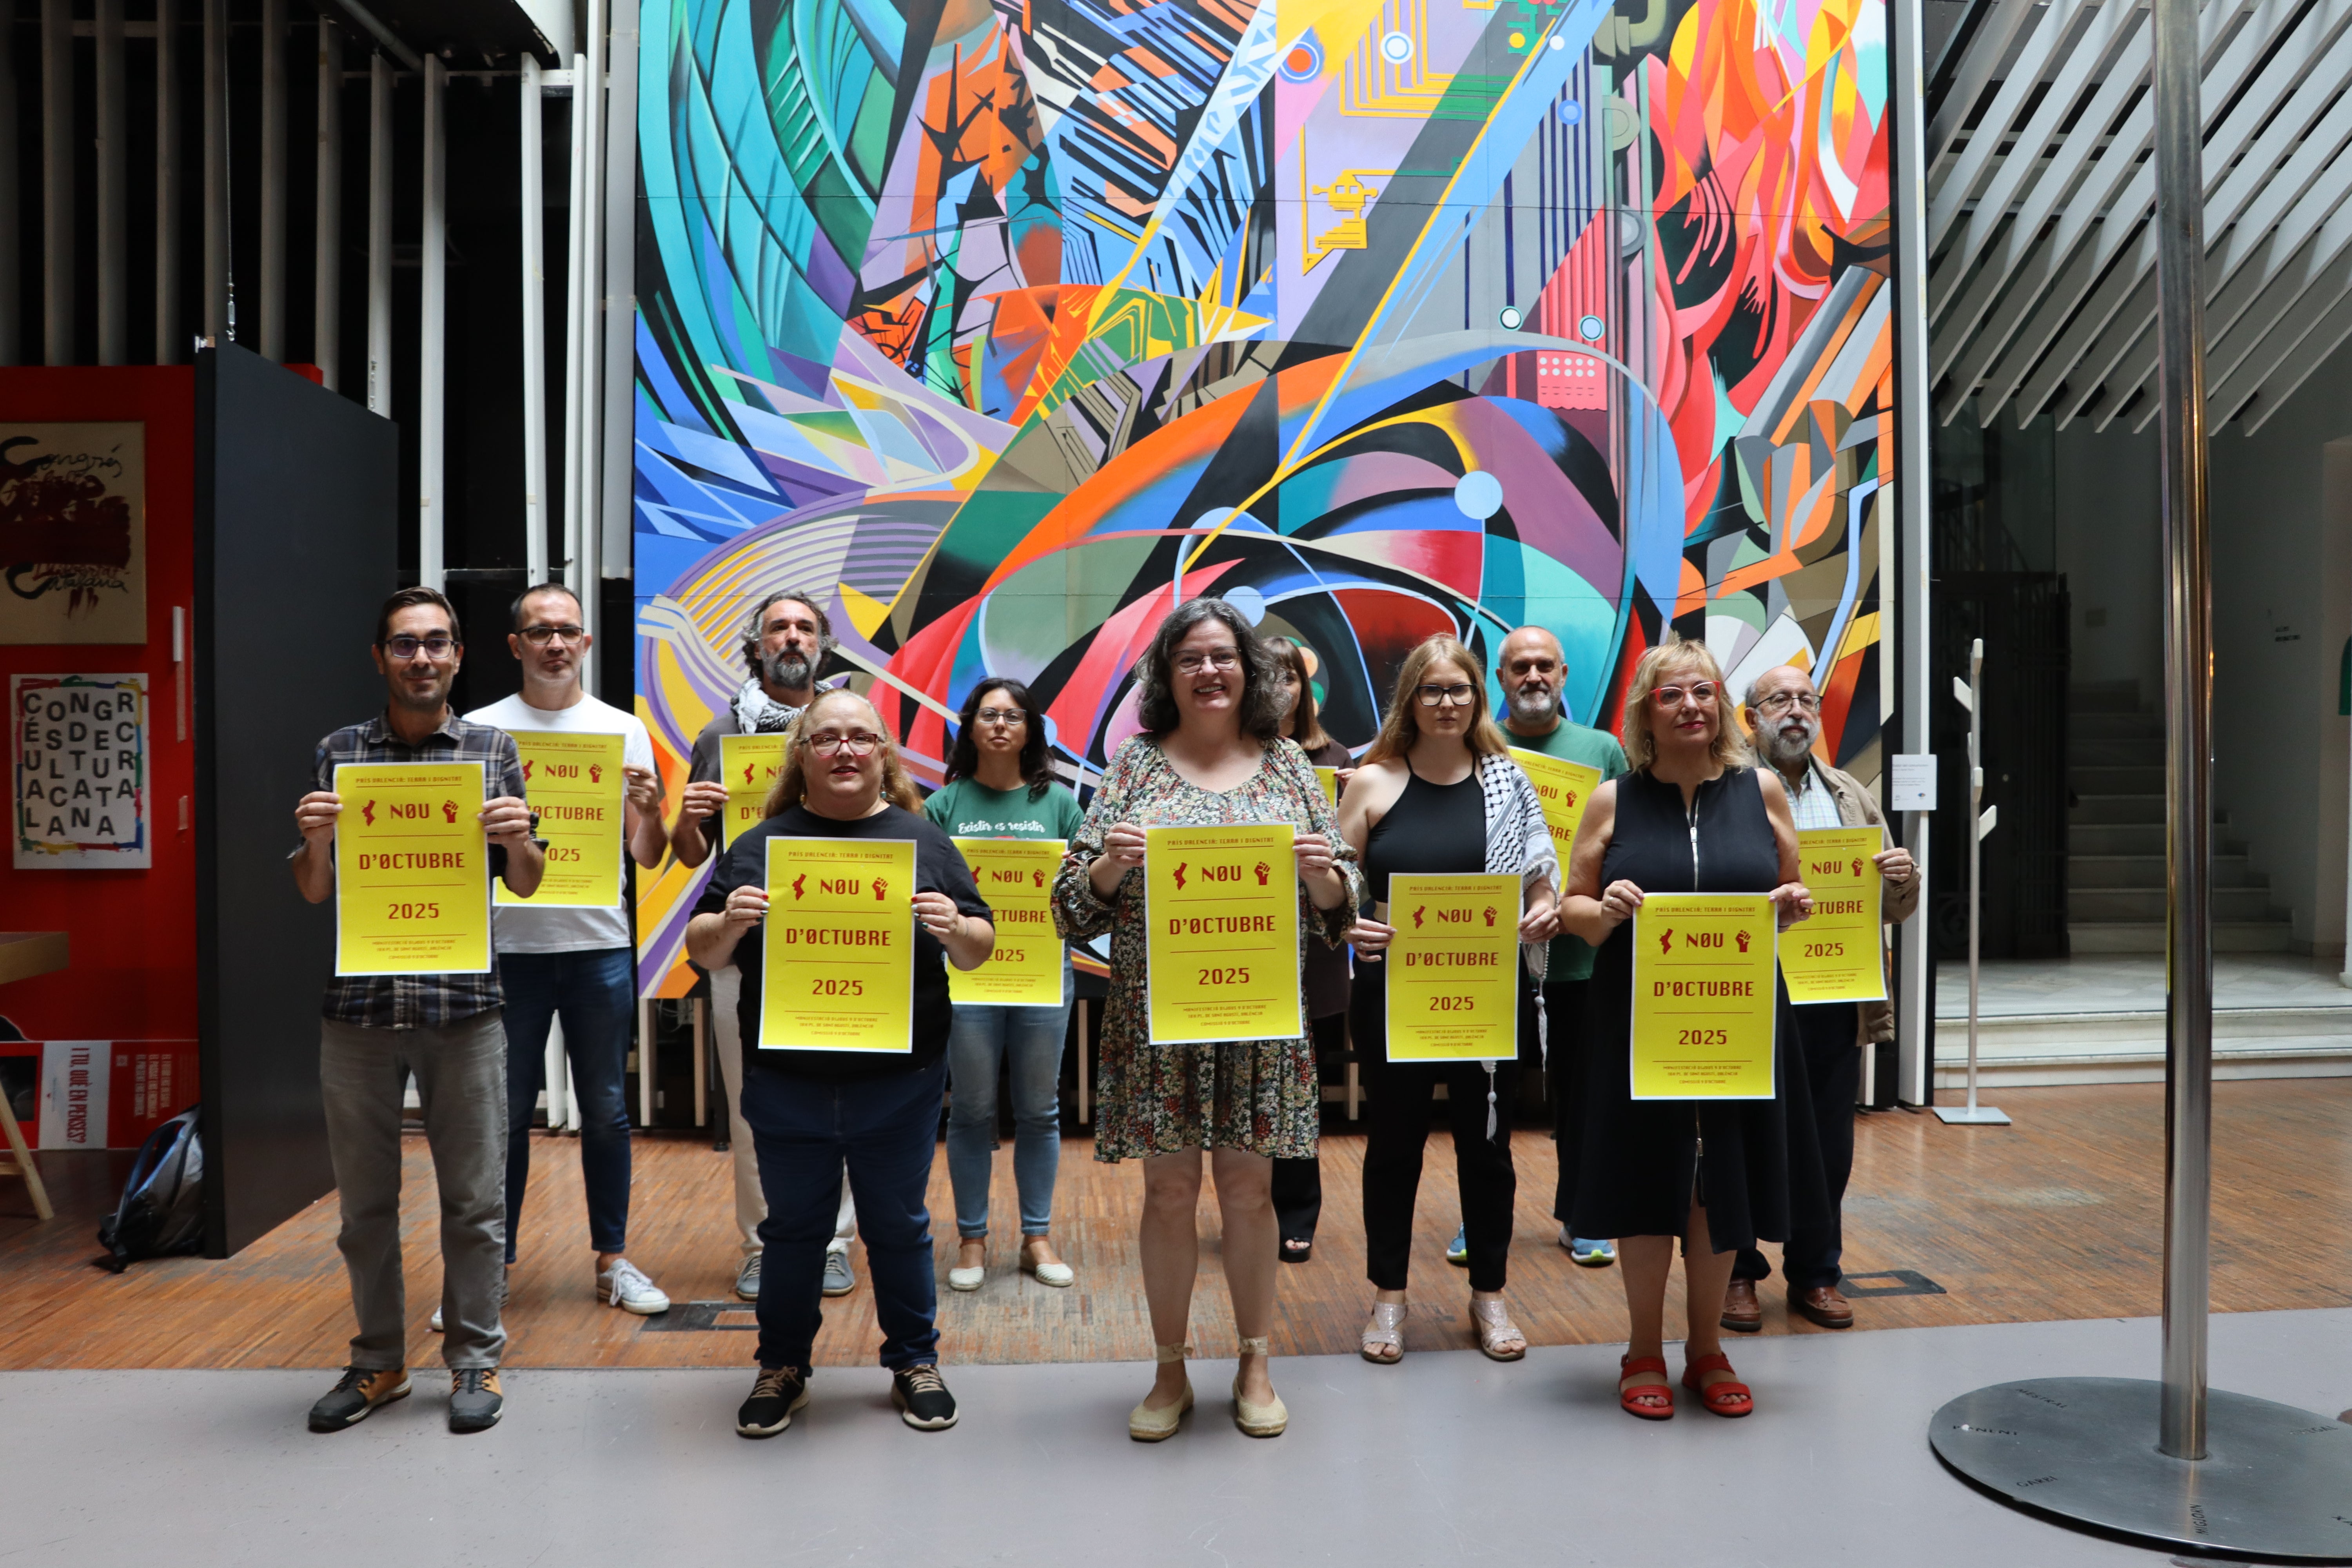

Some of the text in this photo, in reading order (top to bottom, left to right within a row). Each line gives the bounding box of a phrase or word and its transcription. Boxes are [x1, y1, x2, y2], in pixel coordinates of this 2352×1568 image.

[958, 820, 1045, 834] Existir es resistir
[543, 848, 580, 862] 025
[388, 903, 439, 919] 2025
[987, 949, 1025, 962] 025
[1804, 943, 1844, 957] 2025
[1198, 967, 1249, 985] 2025
[812, 979, 862, 996] 2025
[1429, 996, 1474, 1011] 2025
[1679, 1029, 1727, 1045] 2025
[66, 1104, 87, 1143] PENSES?
